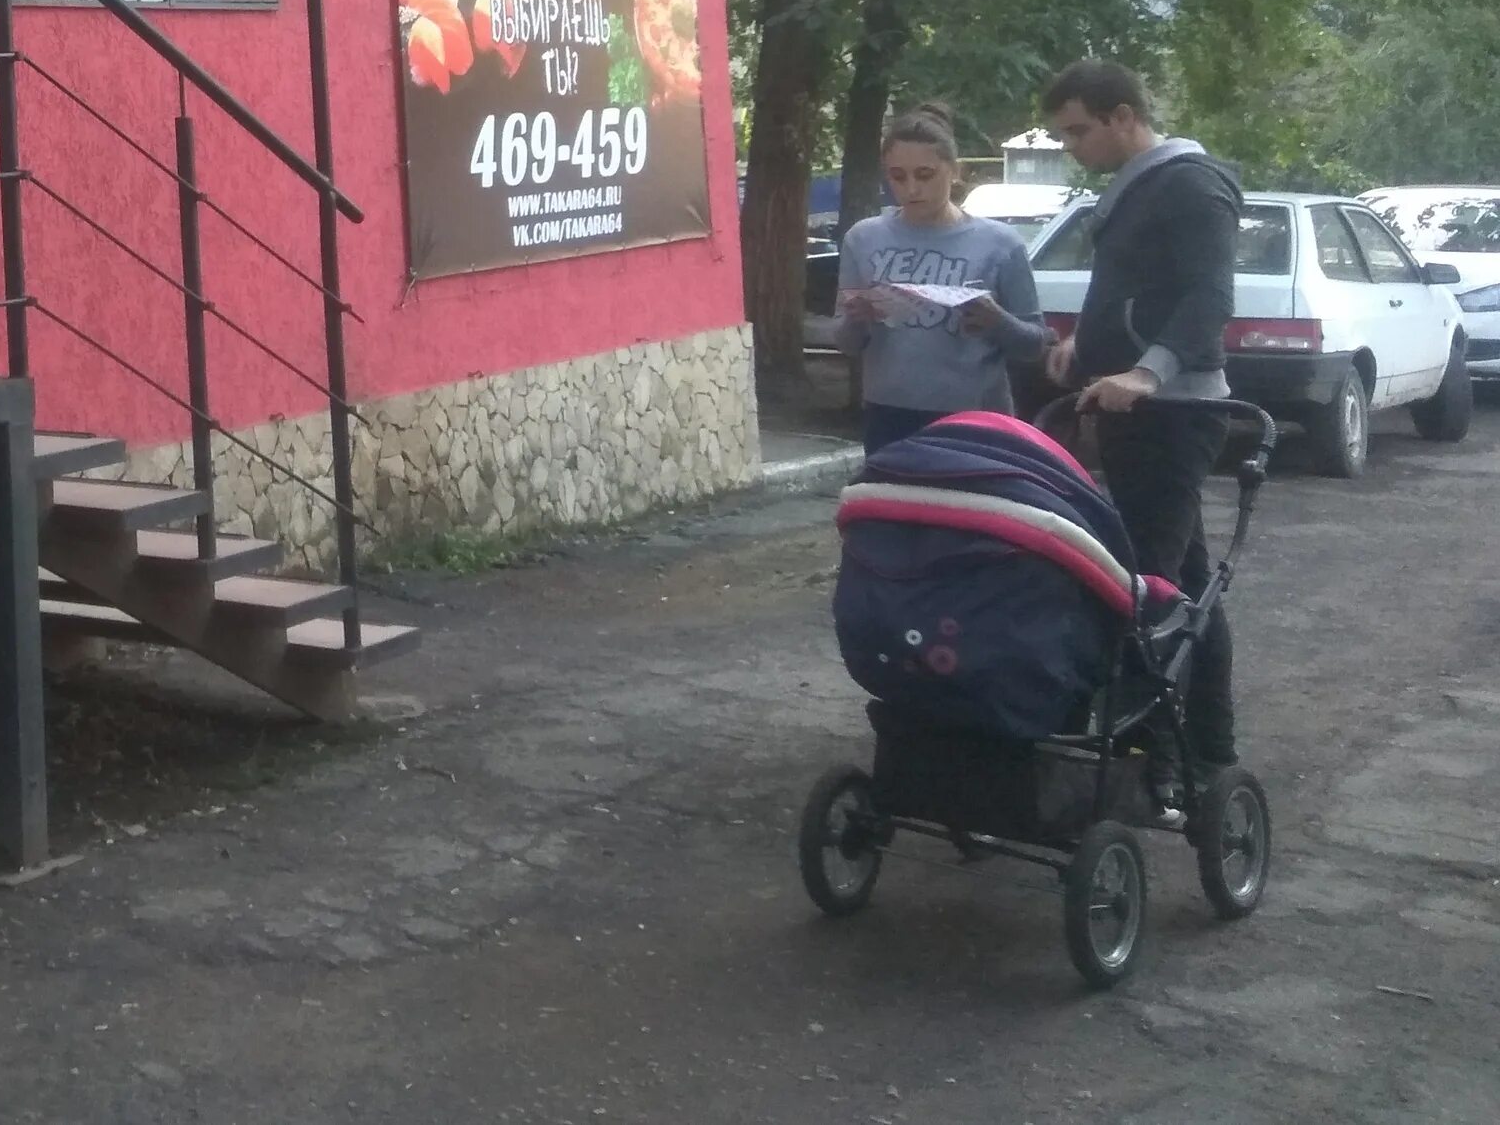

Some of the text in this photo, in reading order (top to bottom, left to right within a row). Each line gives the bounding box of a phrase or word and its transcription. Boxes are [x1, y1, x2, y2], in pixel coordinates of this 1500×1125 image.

[541, 45, 580, 96] ТЫ?
[470, 105, 649, 189] 469-459
[507, 185, 622, 218] WWW.TAKARA64.RU
[512, 211, 623, 247] VK.COM/TAKARA64
[870, 247, 968, 286] YEAH
